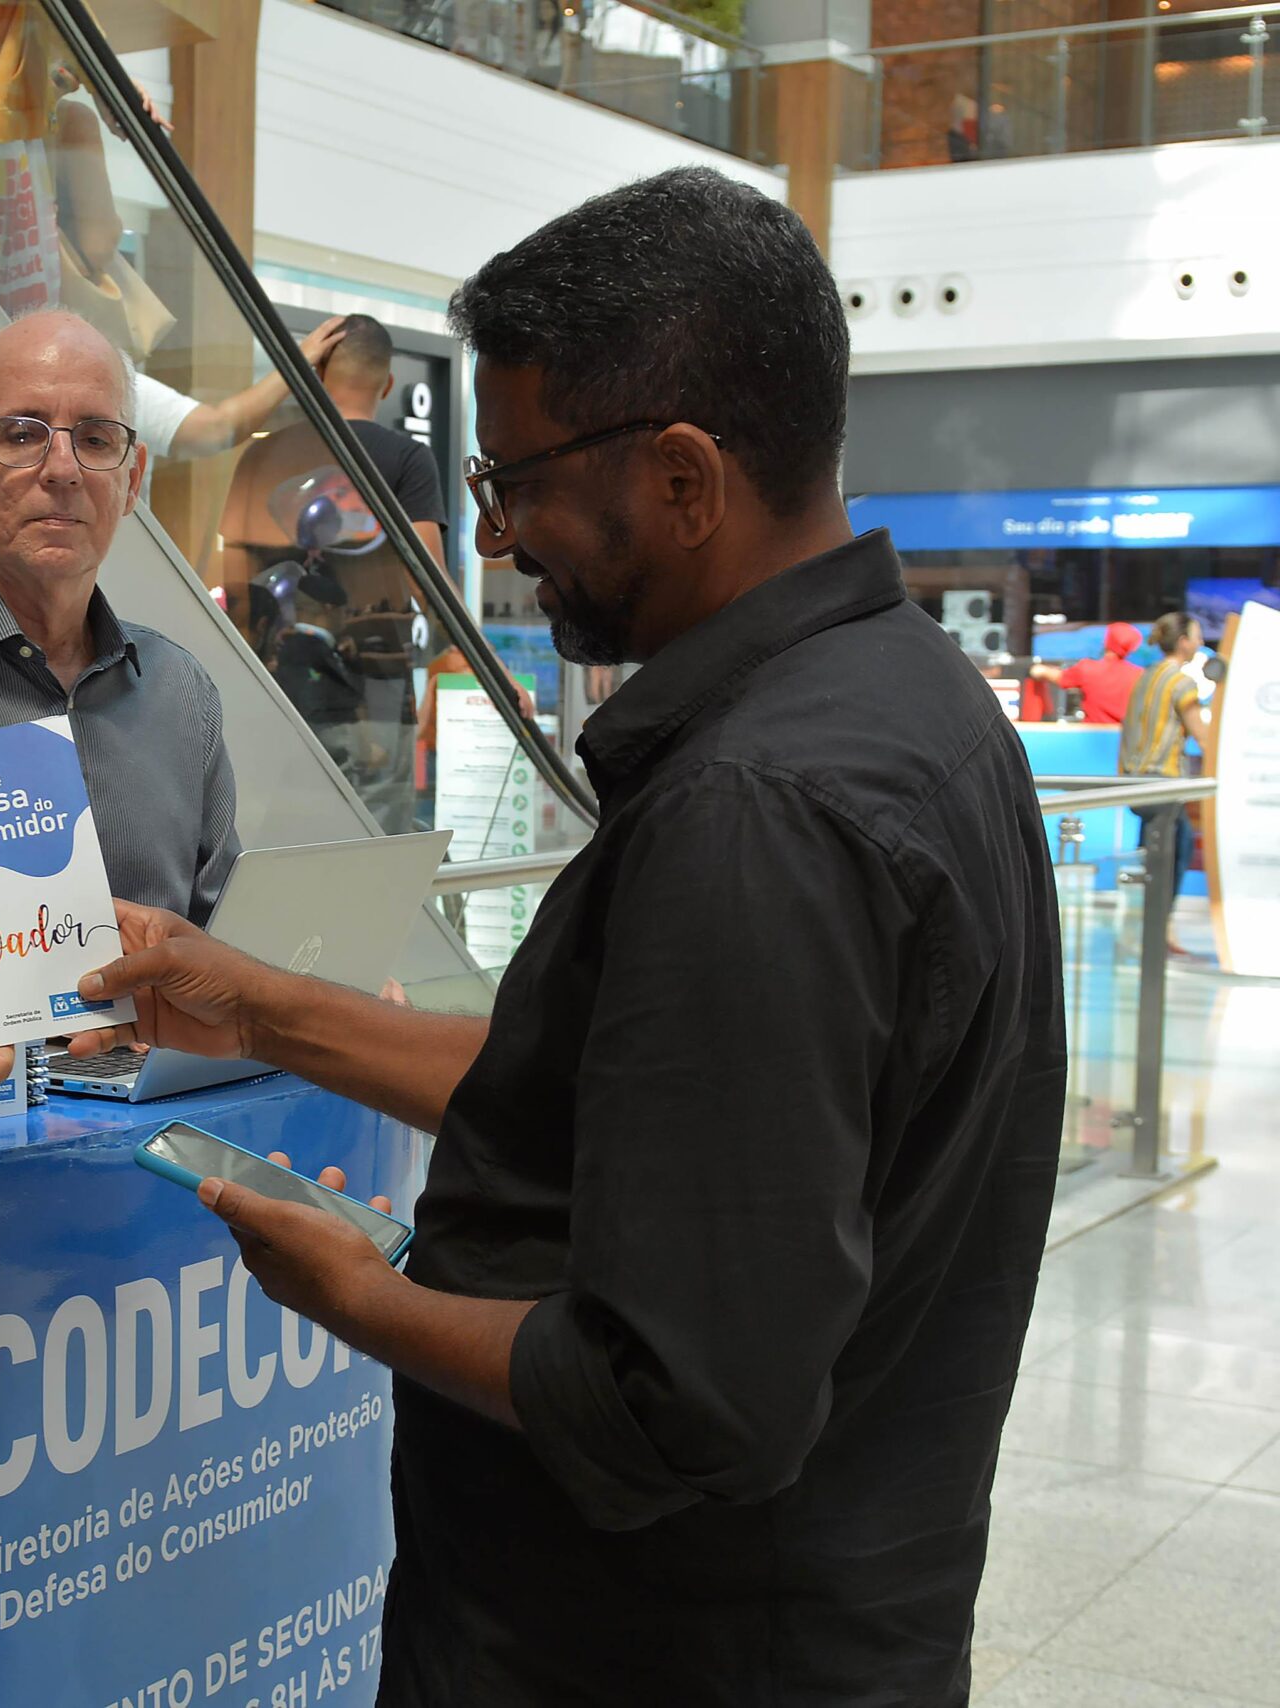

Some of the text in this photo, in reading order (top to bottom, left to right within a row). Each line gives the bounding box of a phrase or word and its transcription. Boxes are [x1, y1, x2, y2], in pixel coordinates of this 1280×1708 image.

[34, 798, 53, 812] do
[119, 1487, 154, 1528] de
[163, 1456, 244, 1511] Ações
[251, 1436, 281, 1473] de
[289, 1391, 382, 1459] Proteção
[0, 1563, 107, 1630] Defesa
[116, 1541, 152, 1582] do
[161, 1473, 313, 1562] Consumidor
[105, 1564, 386, 1708] TO DE SEGUNDA
[316, 1646, 352, 1701] ÀS
